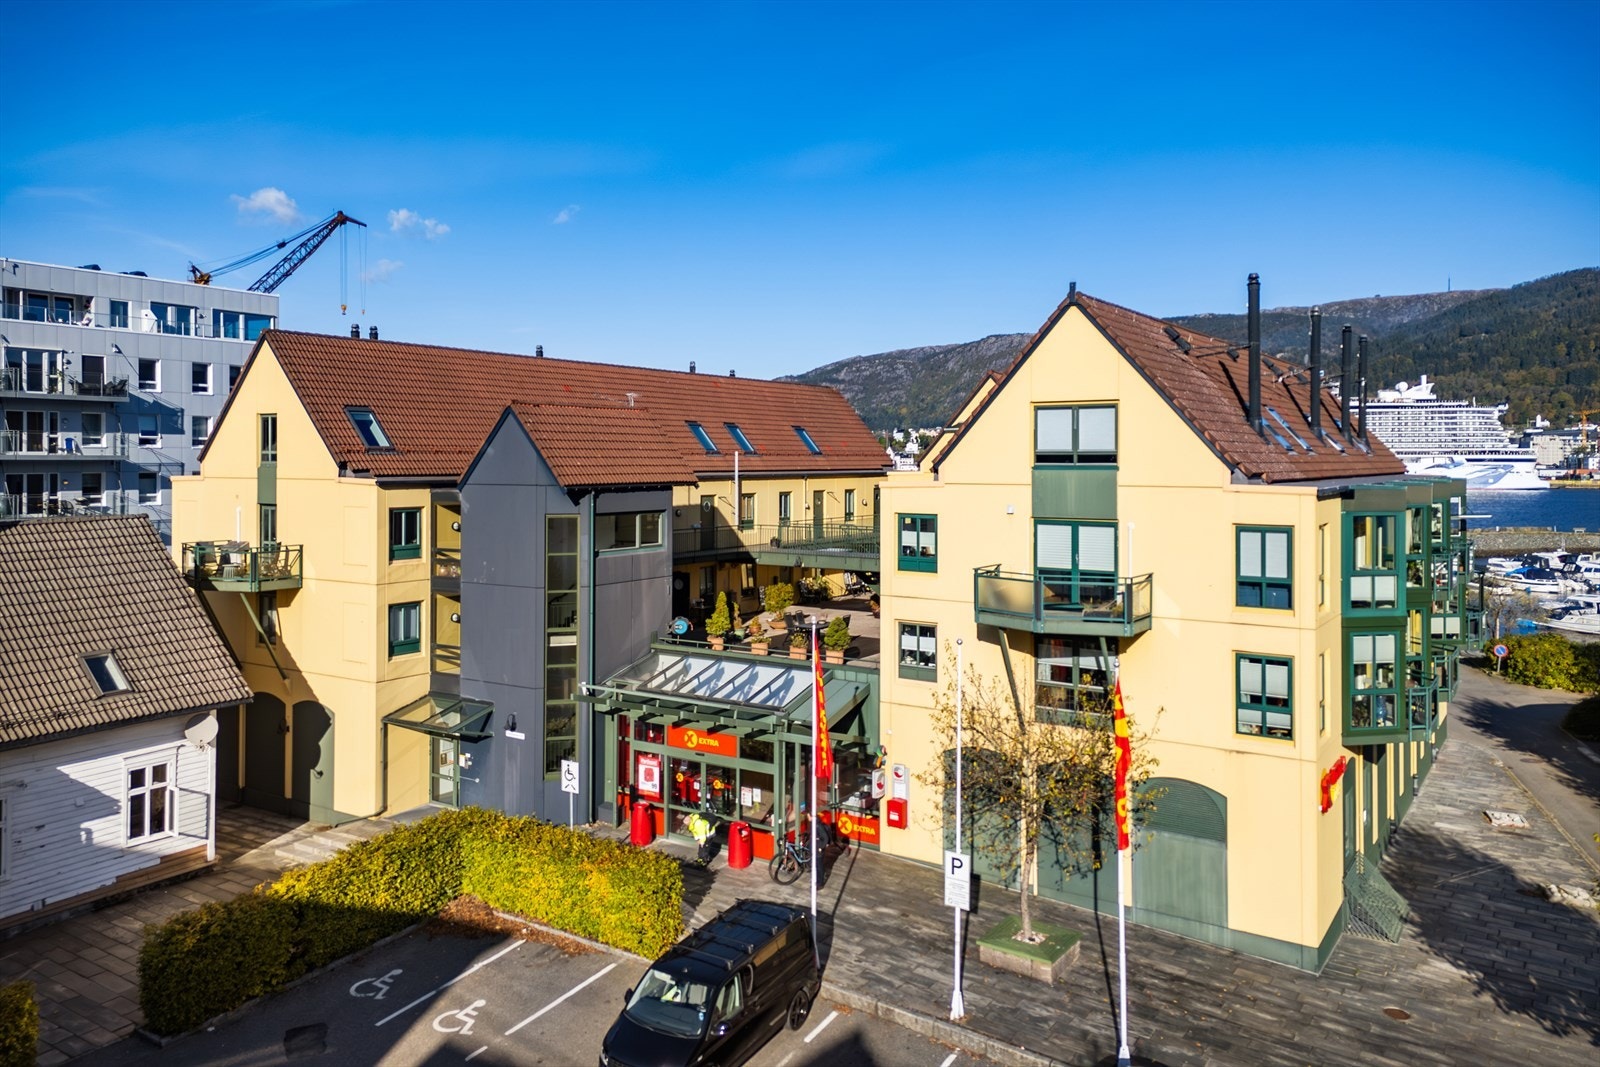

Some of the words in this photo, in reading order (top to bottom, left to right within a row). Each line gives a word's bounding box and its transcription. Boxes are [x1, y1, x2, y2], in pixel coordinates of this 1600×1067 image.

[698, 737, 720, 747] EXTRA
[853, 824, 876, 835] EXTRA
[951, 857, 963, 875] P
